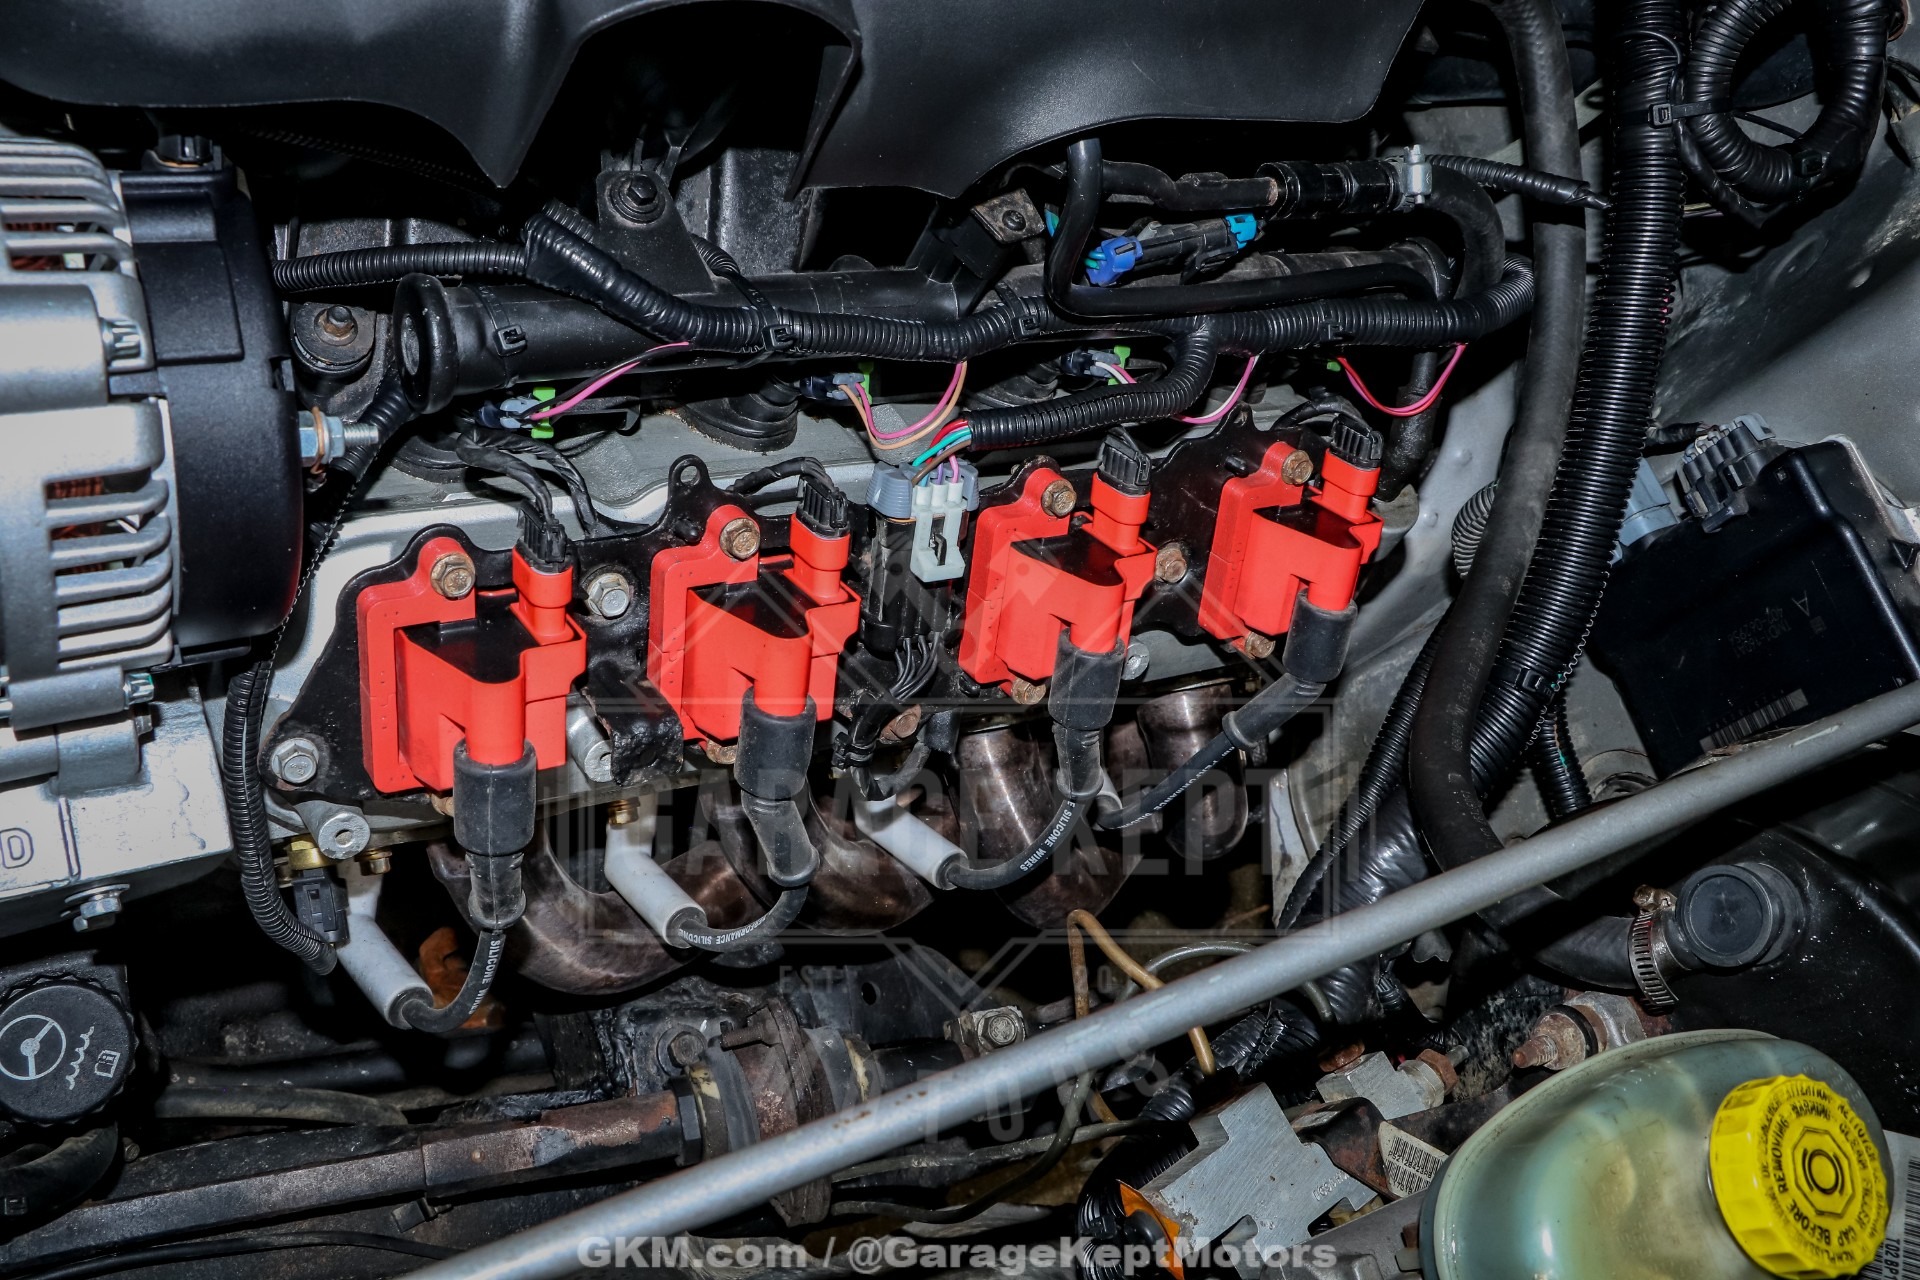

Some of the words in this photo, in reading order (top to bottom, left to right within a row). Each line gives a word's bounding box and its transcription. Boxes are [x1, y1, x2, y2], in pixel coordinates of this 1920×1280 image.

[1044, 809, 1072, 847] SILICONE
[1019, 848, 1047, 872] WIRES
[678, 928, 712, 945] SILICONE
[715, 915, 767, 945] PERFORMANCE
[481, 940, 501, 984] SILICONE
[1769, 1113, 1790, 1194] REMOVING
[1786, 1198, 1831, 1247] BEFORE
[1836, 1224, 1858, 1246] CAP
